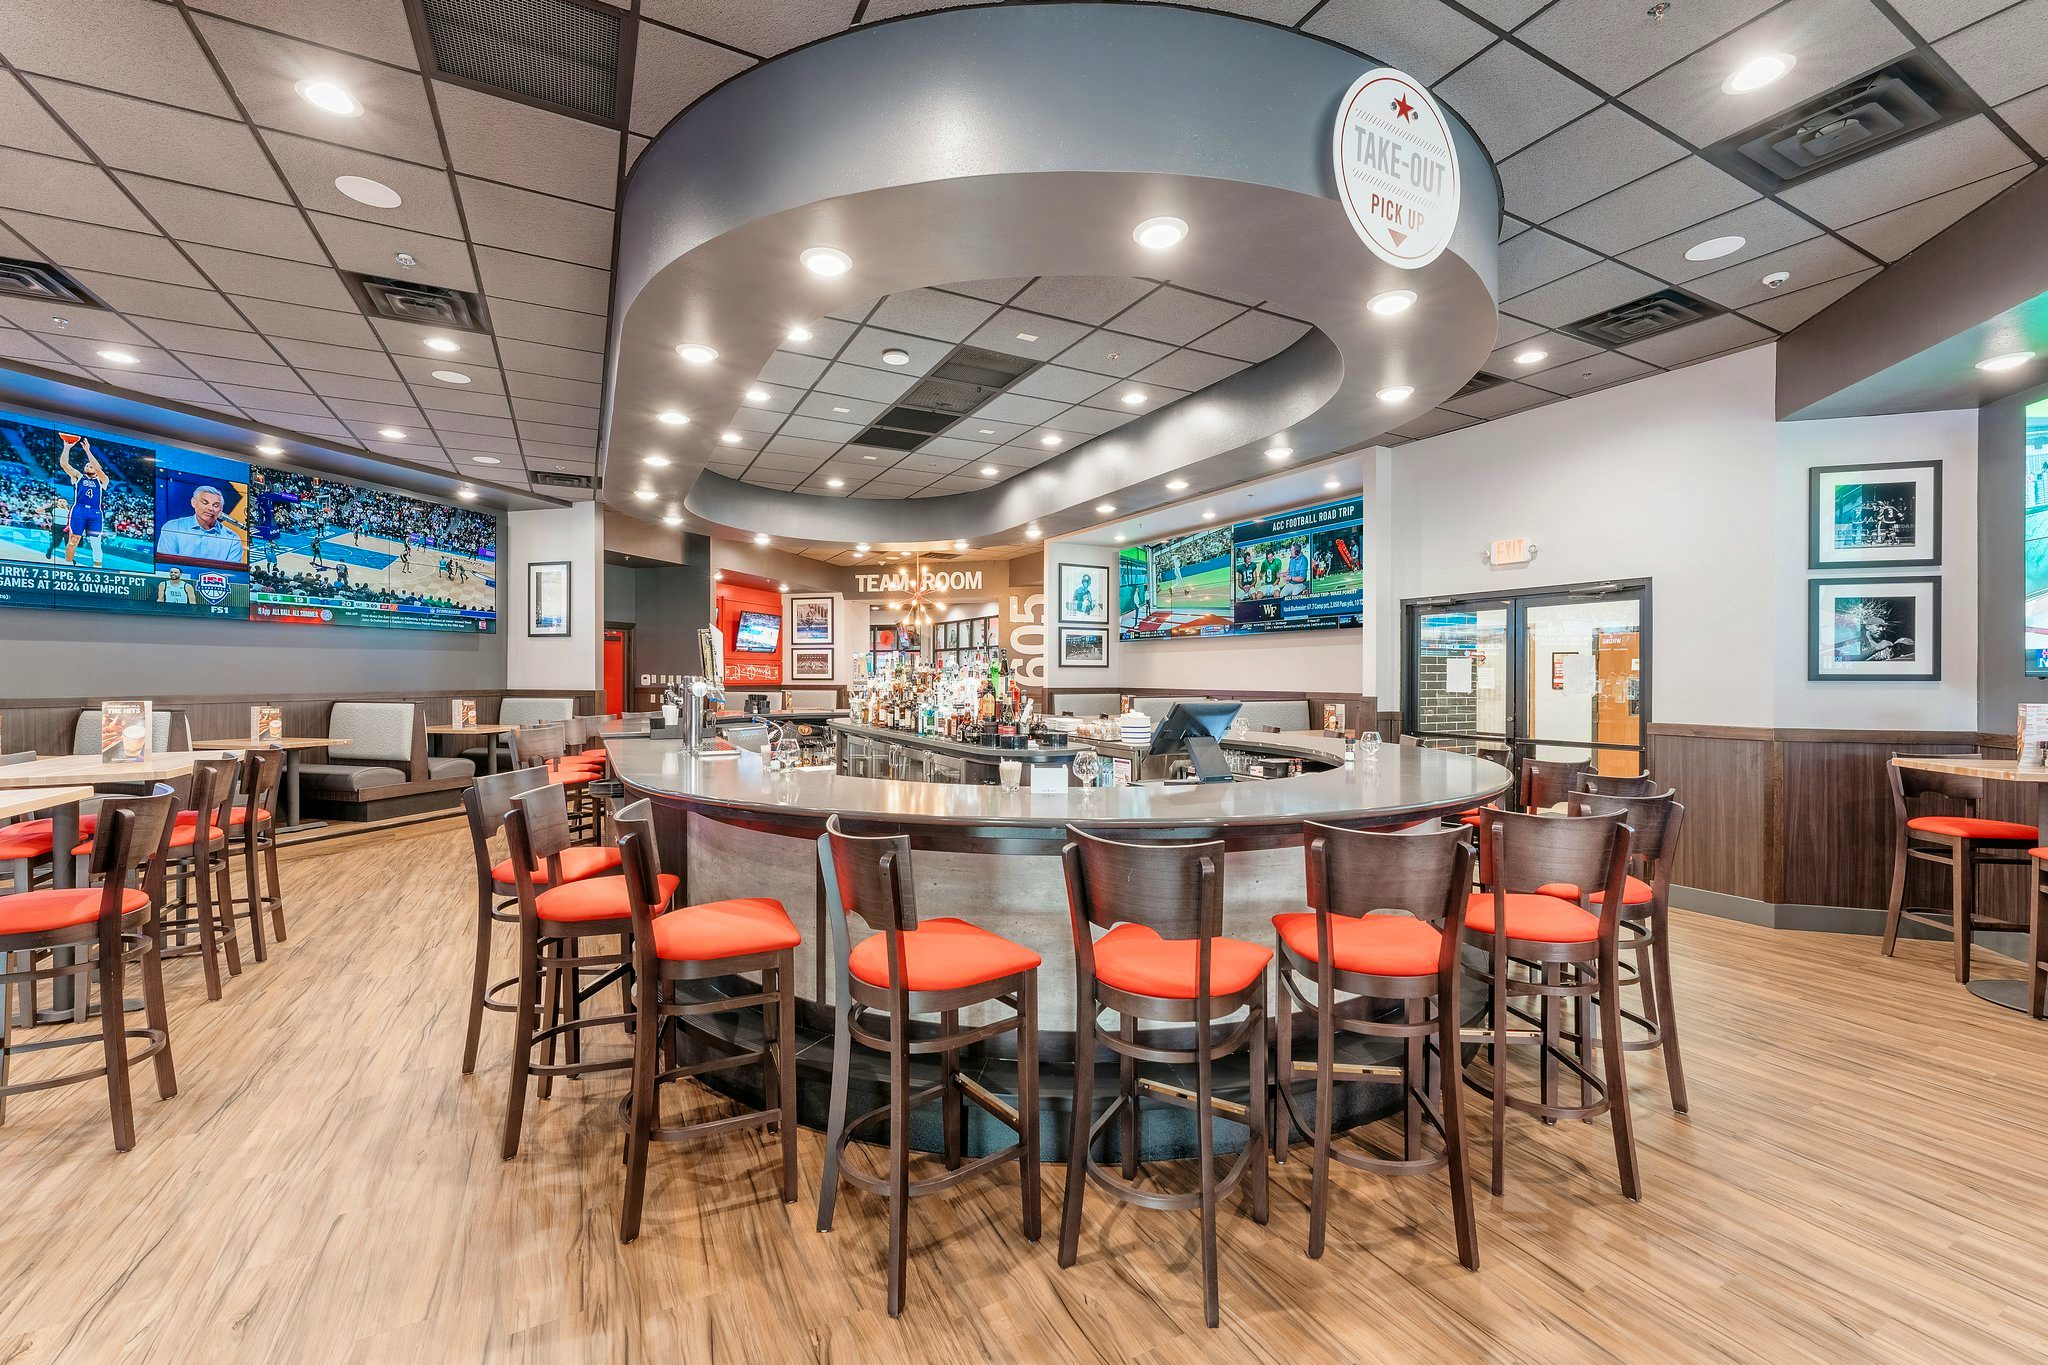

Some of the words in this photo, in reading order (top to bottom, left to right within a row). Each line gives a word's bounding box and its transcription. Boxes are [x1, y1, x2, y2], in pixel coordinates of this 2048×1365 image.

[1354, 125, 1446, 197] TAKE-OUT
[1371, 193, 1403, 226] PICK
[1408, 209, 1425, 232] UP
[85, 488, 94, 499] 4
[1272, 521, 1285, 532] ACC
[1285, 513, 1318, 529] FOOTBALL
[1318, 509, 1337, 521] ROAD
[1338, 505, 1355, 518] TRIP
[1497, 539, 1524, 562] EXIT
[32, 568, 49, 579] 7.3
[52, 570, 76, 582] PPG,
[79, 572, 101, 583] 26.3
[103, 574, 127, 586] 3-PT
[129, 577, 147, 587] PCT
[855, 573, 910, 592] TEAM
[922, 570, 983, 590] ROOM
[1242, 569, 1253, 583] 15
[1266, 569, 1273, 582] 9
[37, 579, 51, 590] AT
[53, 581, 80, 592] 2024
[82, 583, 130, 595] OLYMPICS
[210, 606, 229, 614] FS1
[1009, 593, 1044, 687] 605
